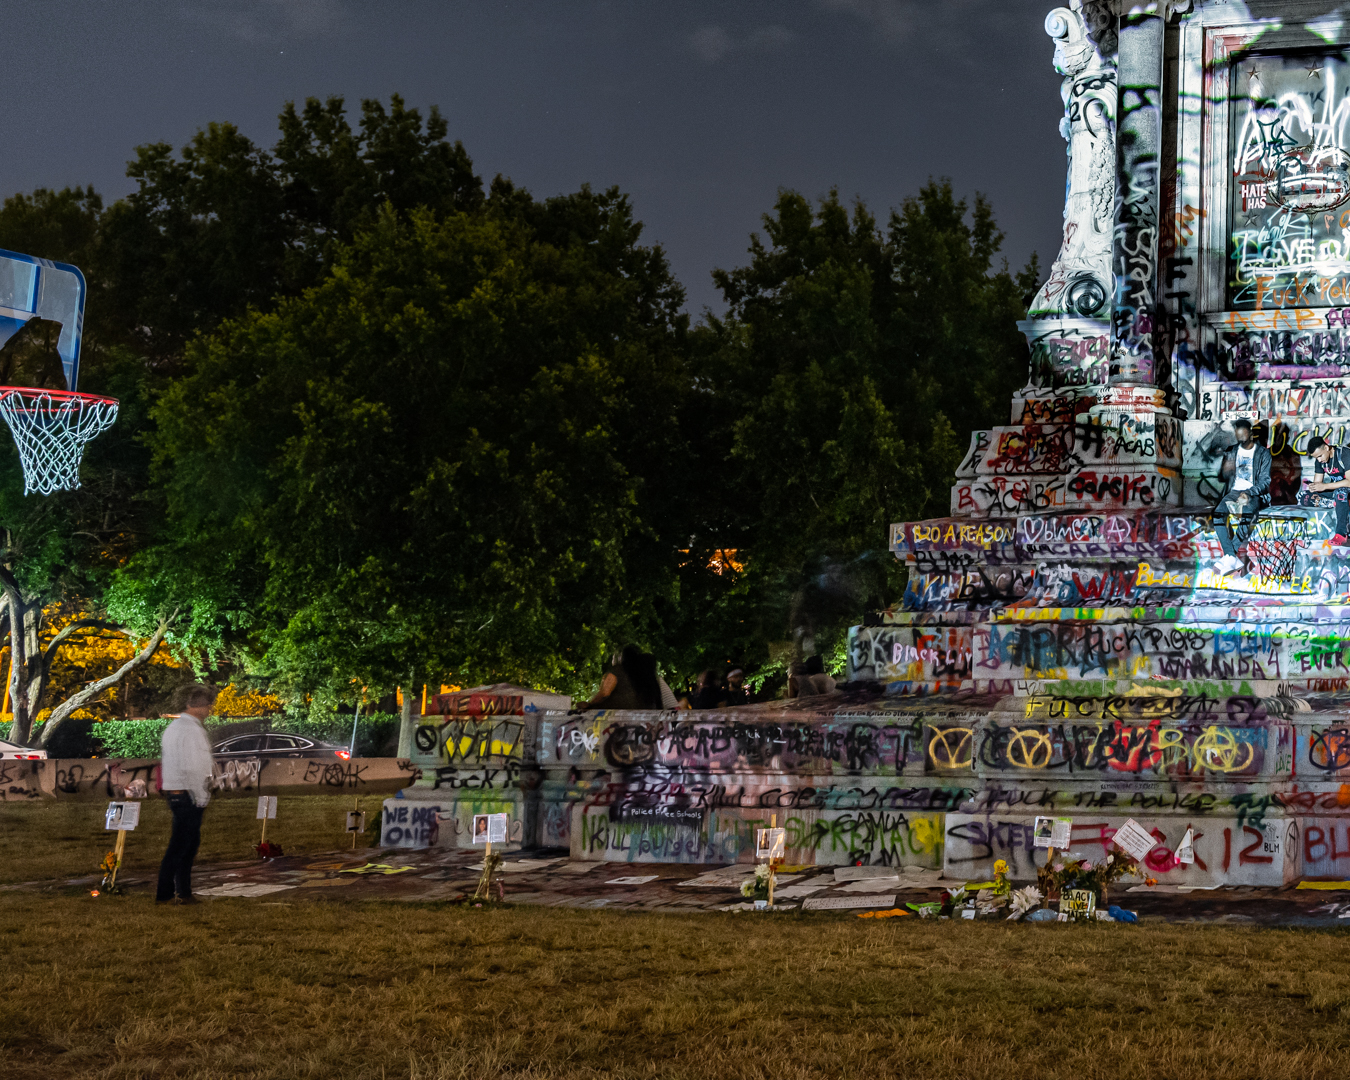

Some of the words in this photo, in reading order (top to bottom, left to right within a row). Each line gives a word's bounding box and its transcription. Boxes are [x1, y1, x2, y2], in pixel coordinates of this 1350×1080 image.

[1241, 184, 1267, 198] HATE
[1247, 197, 1268, 210] HAS
[1254, 275, 1310, 311] Fuck
[1225, 308, 1322, 331] ACAB
[1114, 436, 1155, 457] ACAB
[944, 525, 956, 545] A
[959, 524, 1016, 545] REASON
[1135, 562, 1193, 589] BLACK
[892, 642, 939, 666] Black
[1158, 655, 1266, 680] WAKANDA
[1300, 647, 1349, 674] EVER
[384, 805, 408, 823] WE
[631, 807, 653, 816] Police
[676, 809, 701, 819] Schools
[1265, 842, 1280, 853] BLM
